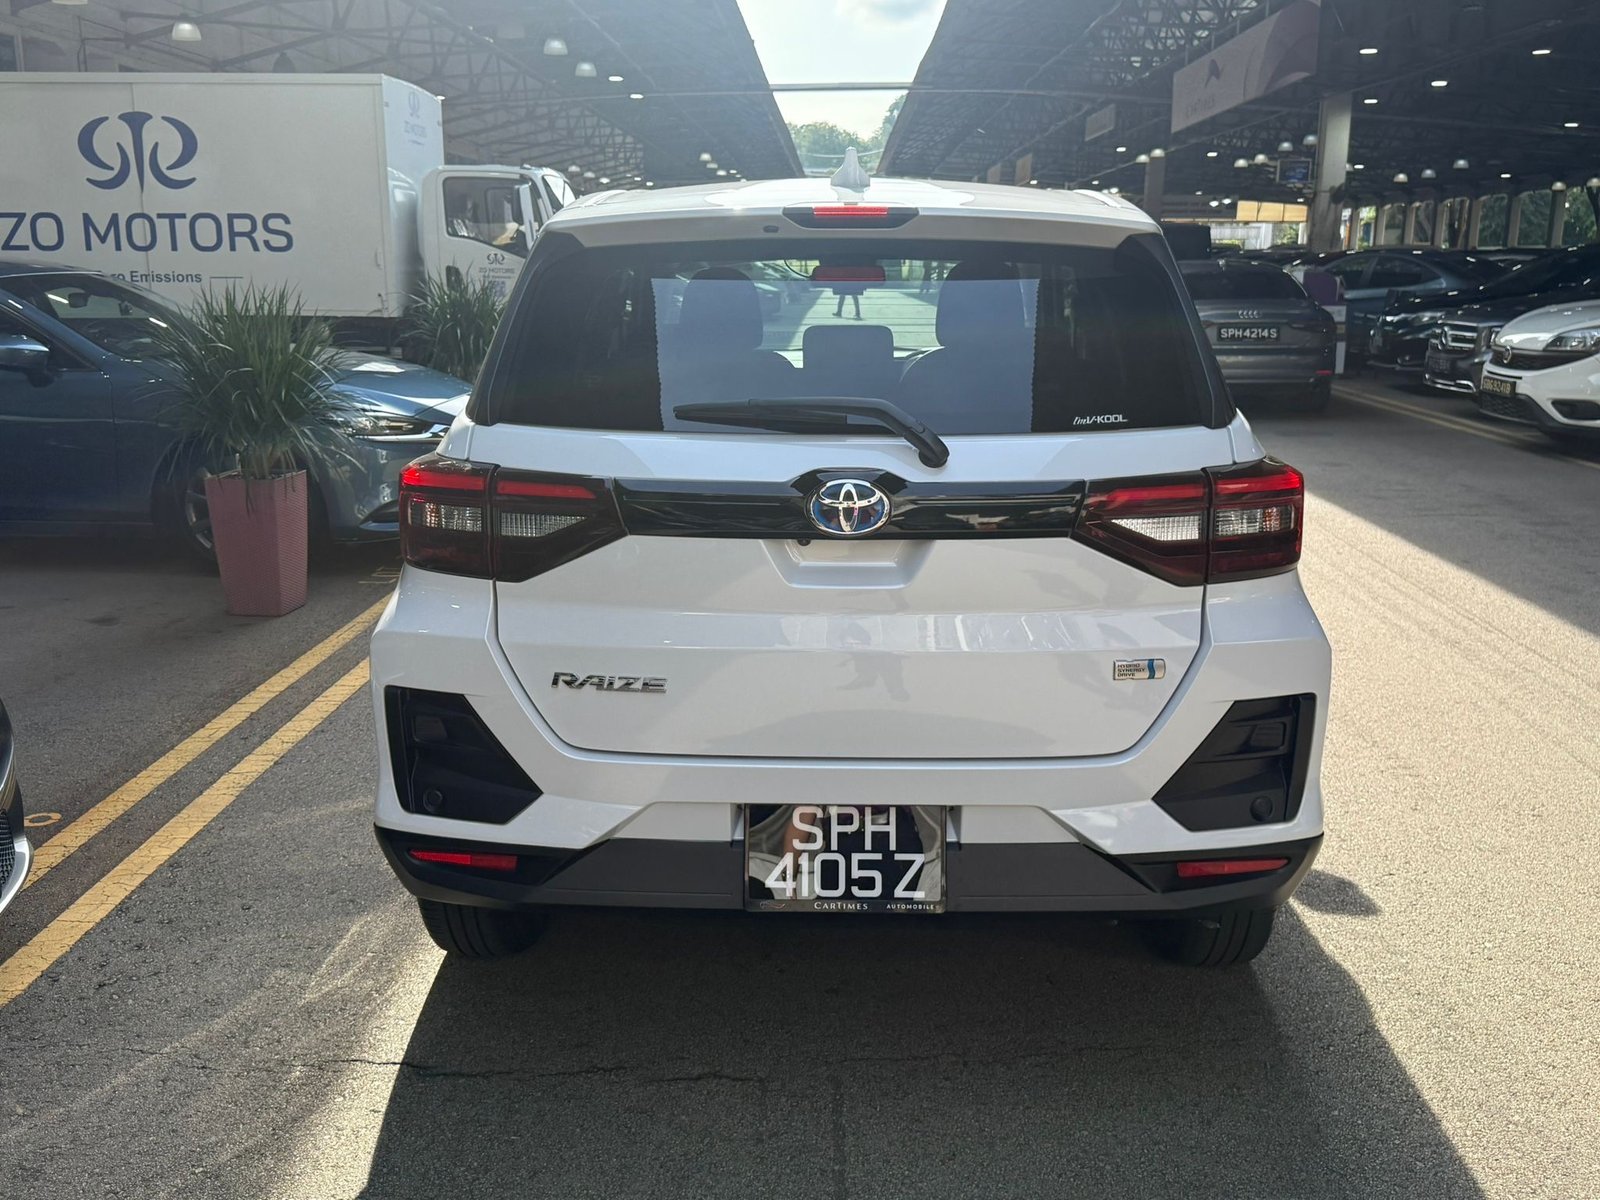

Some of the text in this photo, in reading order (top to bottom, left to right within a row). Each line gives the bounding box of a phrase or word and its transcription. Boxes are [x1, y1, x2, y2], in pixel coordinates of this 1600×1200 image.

[0, 211, 294, 252] ZO MOTORS
[130, 270, 202, 283] Emissions
[551, 671, 668, 694] RAIZE
[792, 805, 897, 851] SPH
[814, 901, 869, 910] CARTIMES
